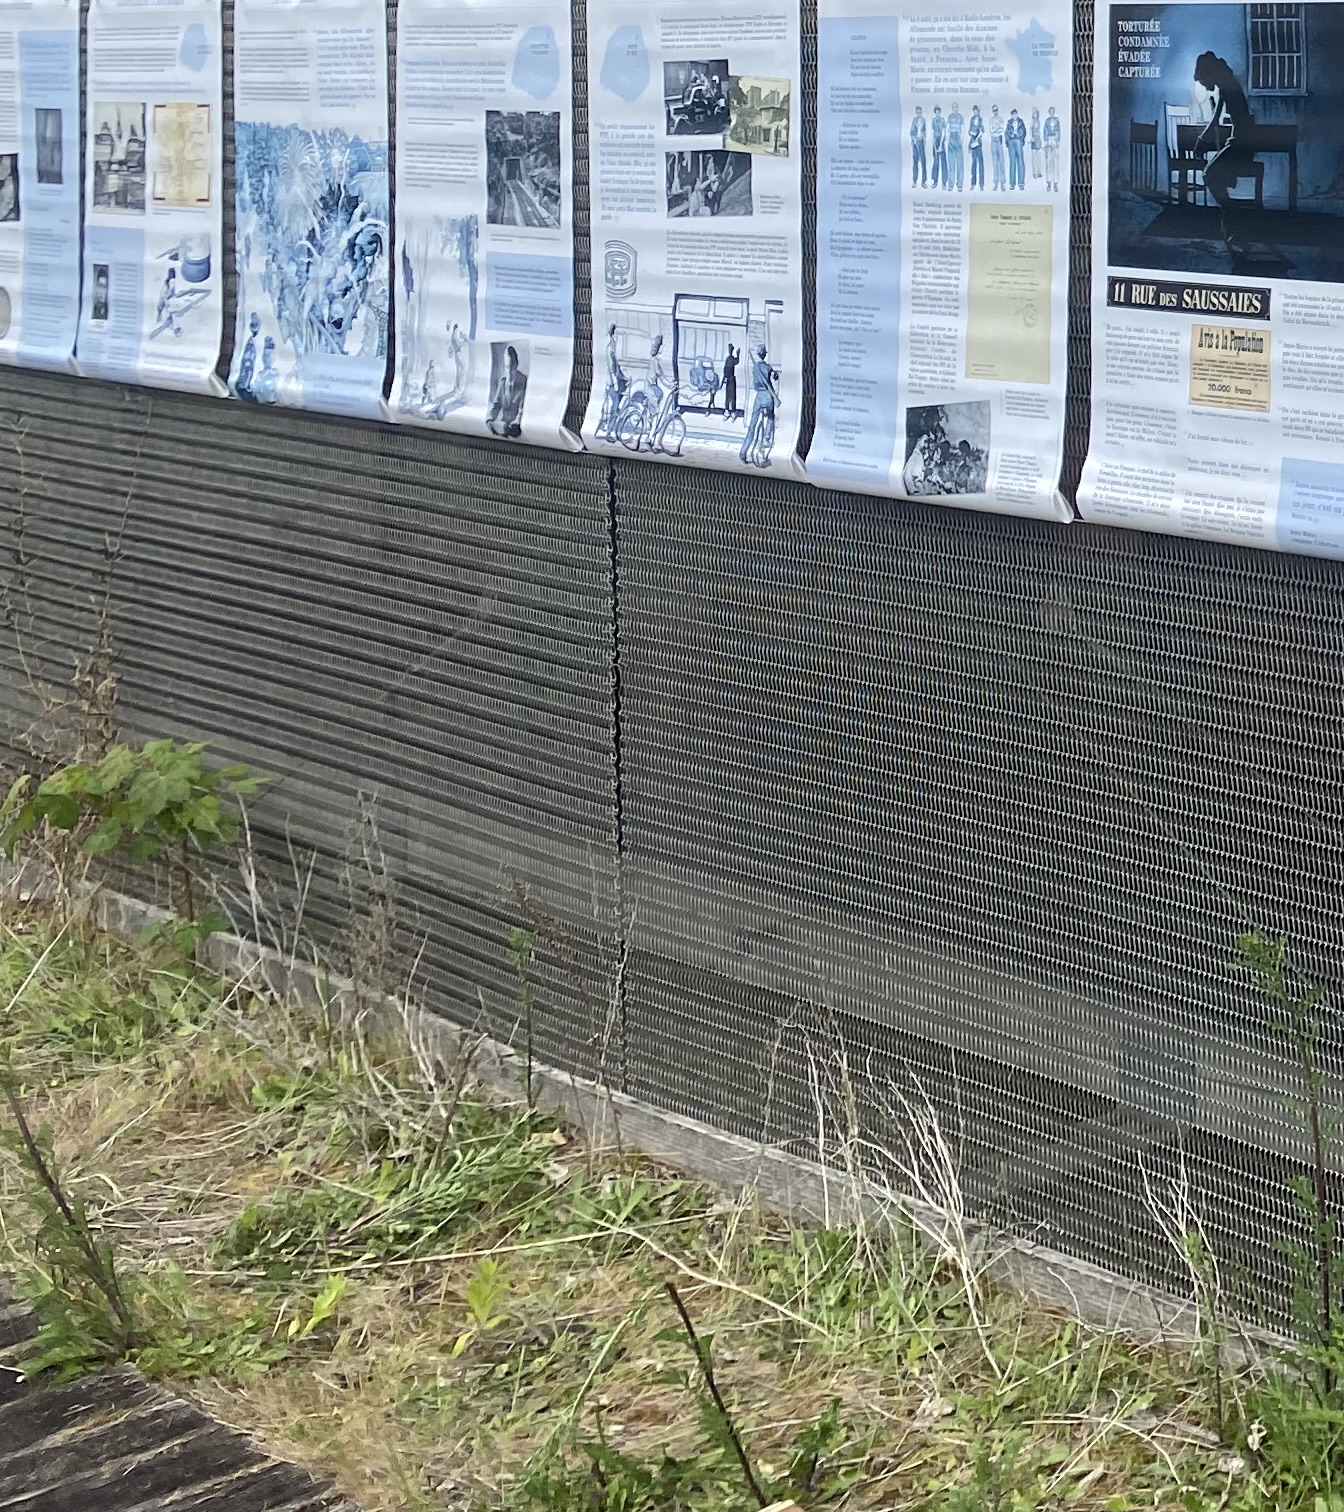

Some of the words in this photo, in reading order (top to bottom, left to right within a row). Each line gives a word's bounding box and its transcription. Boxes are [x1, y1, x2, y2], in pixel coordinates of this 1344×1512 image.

[1118, 18, 1160, 32] TORTURÉE
[1118, 33, 1170, 48] CONDAMNÉE
[1118, 48, 1150, 62] ÉVADÉE
[1118, 64, 1161, 78] CAPTURÉE
[1114, 282, 1126, 302] 11
[1132, 284, 1156, 306] RUE
[1160, 293, 1178, 306] DES
[1182, 289, 1261, 313] SAUSSAIES
